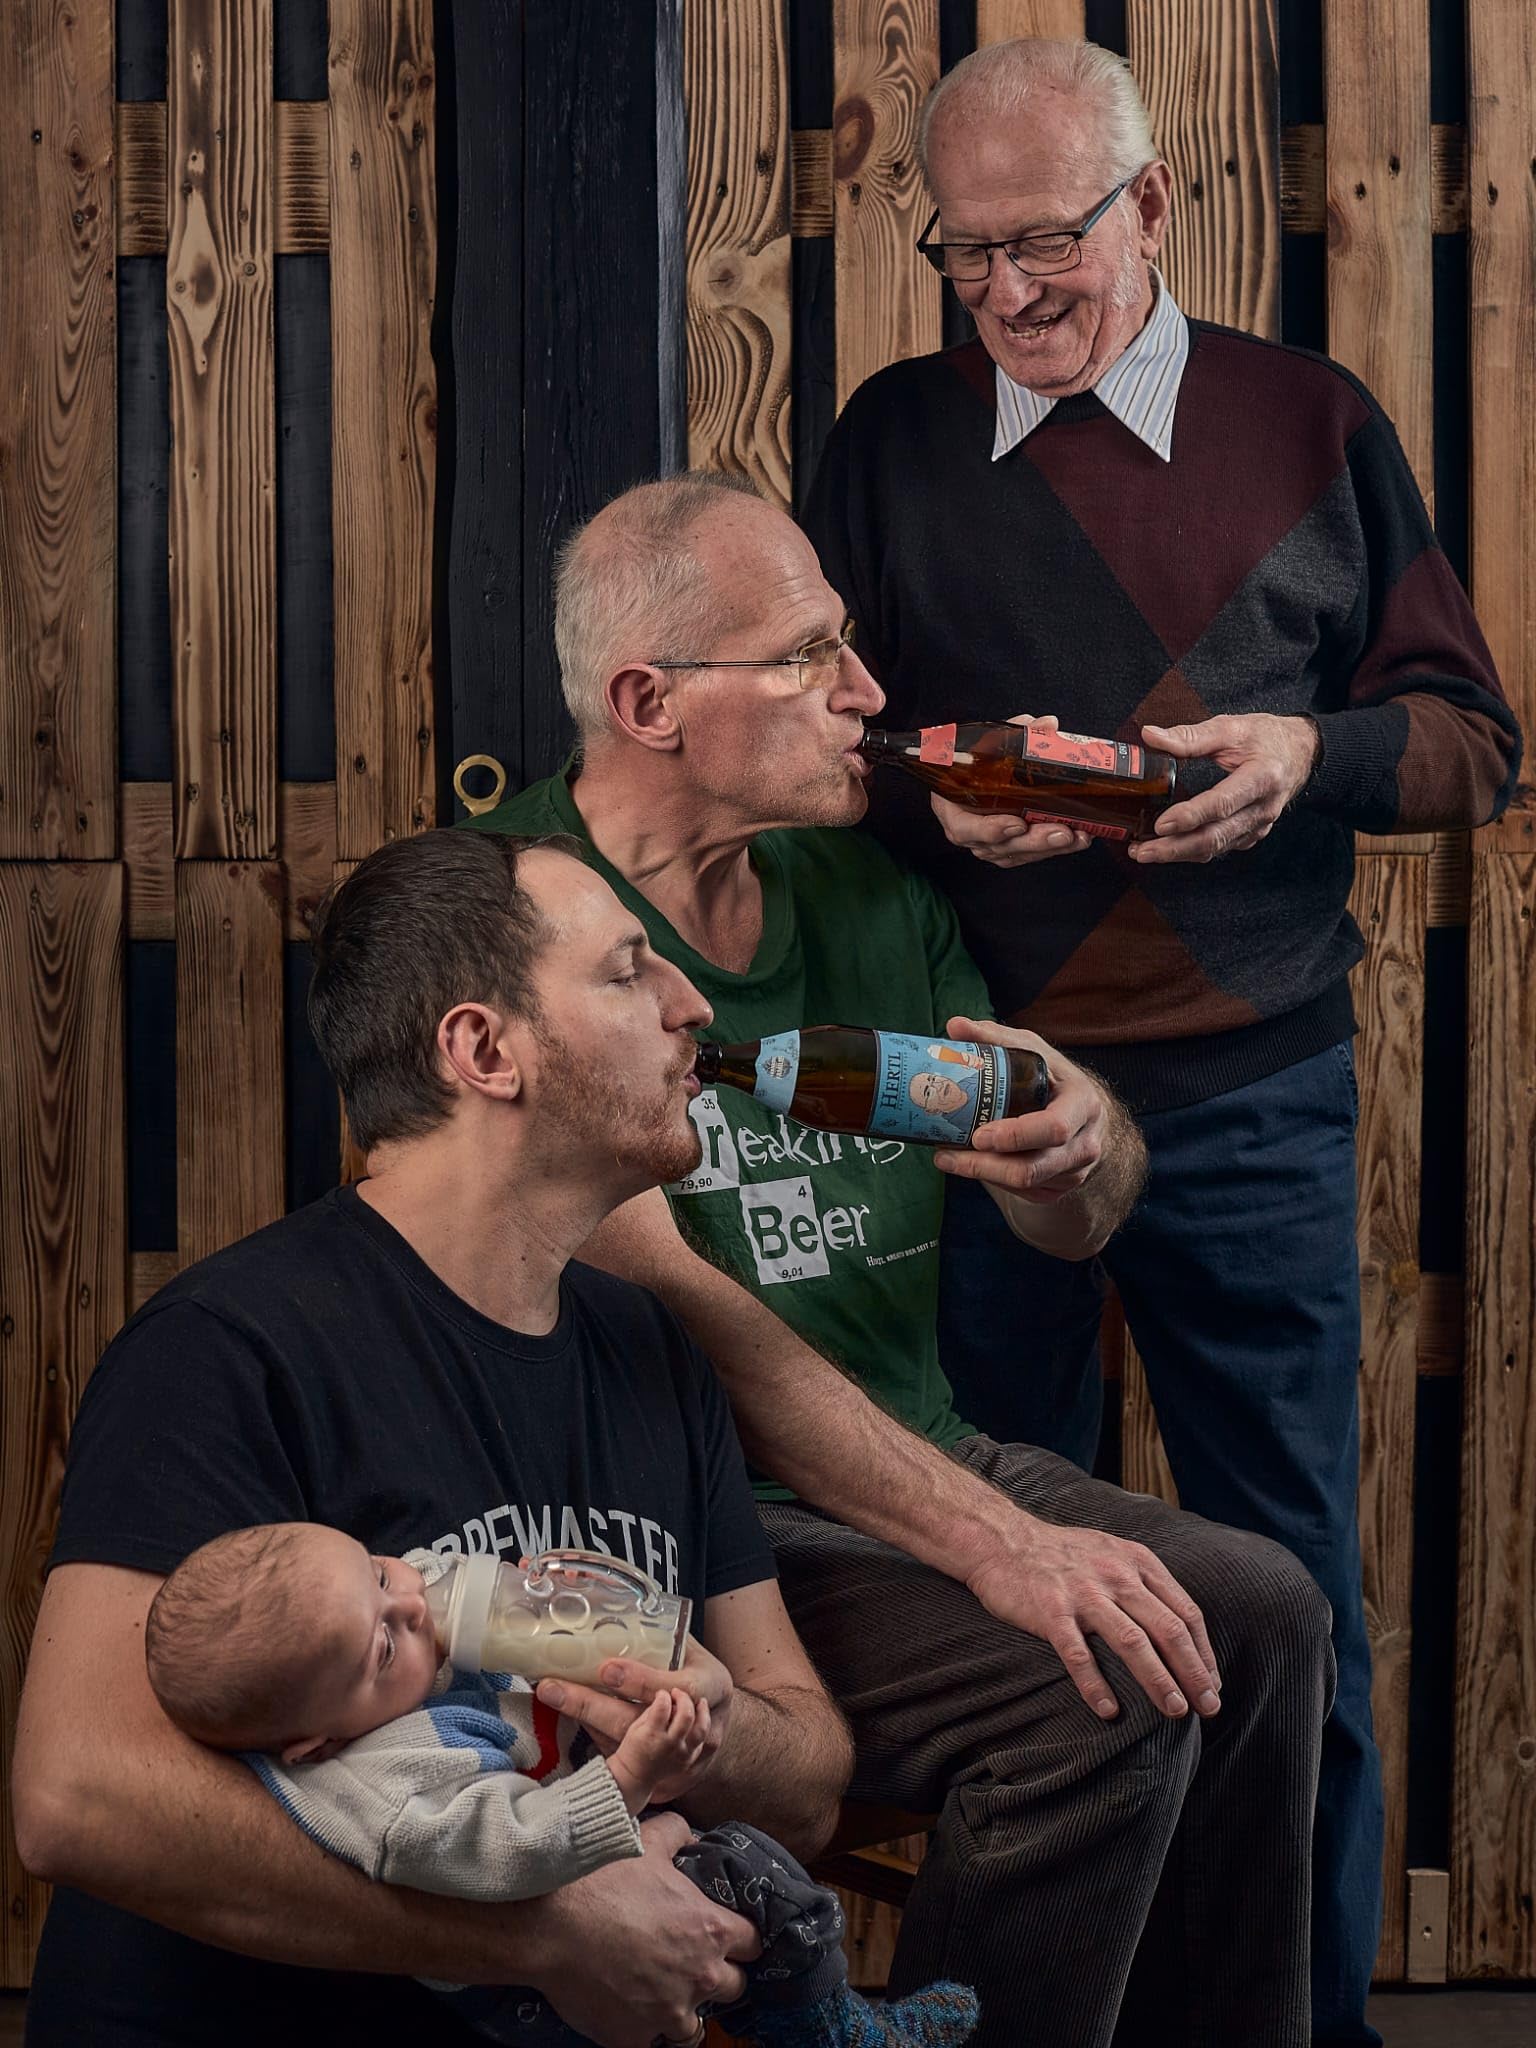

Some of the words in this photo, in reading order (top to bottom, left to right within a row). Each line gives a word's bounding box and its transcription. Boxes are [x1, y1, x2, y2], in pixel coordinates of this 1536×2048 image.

[880, 1051, 902, 1109] HERTL
[701, 1097, 716, 1110] 35
[689, 1113, 906, 1168] reaking
[679, 1177, 713, 1191] 79,90
[797, 1184, 807, 1198] 4
[747, 1204, 870, 1260] Beer
[781, 1266, 803, 1279] 9,01
